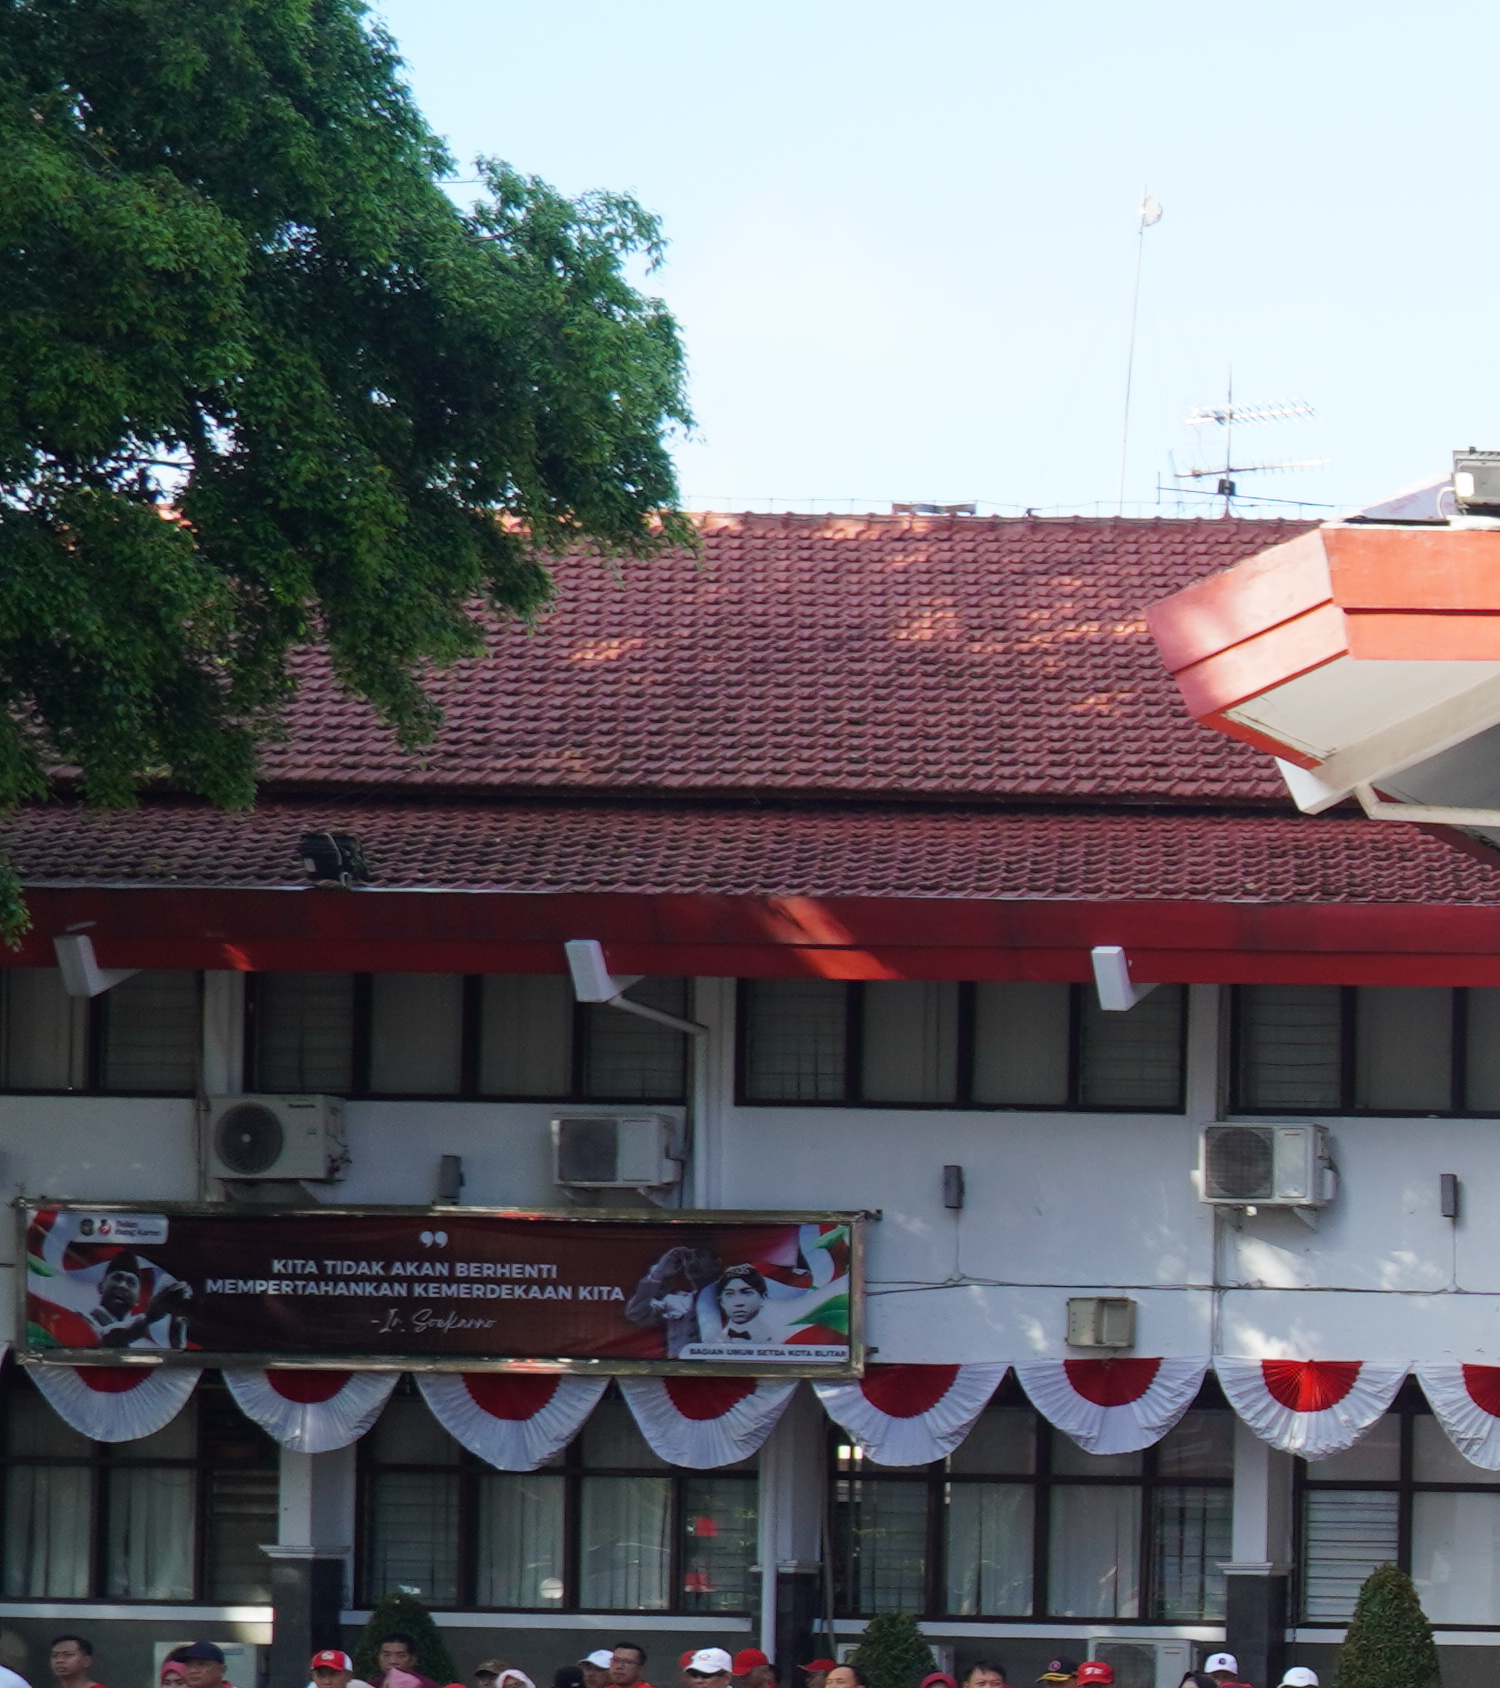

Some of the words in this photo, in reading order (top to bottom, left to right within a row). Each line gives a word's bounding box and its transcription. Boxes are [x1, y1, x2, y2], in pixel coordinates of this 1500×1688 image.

[271, 1259, 317, 1275] KITA
[324, 1260, 385, 1276] TIDAK
[390, 1261, 449, 1277] AKAN
[455, 1262, 558, 1279] BERHENTI
[206, 1279, 408, 1297] MEMPERTAHANKAN
[413, 1282, 573, 1301] KEMERDEKAAN
[578, 1285, 625, 1301] KITA
